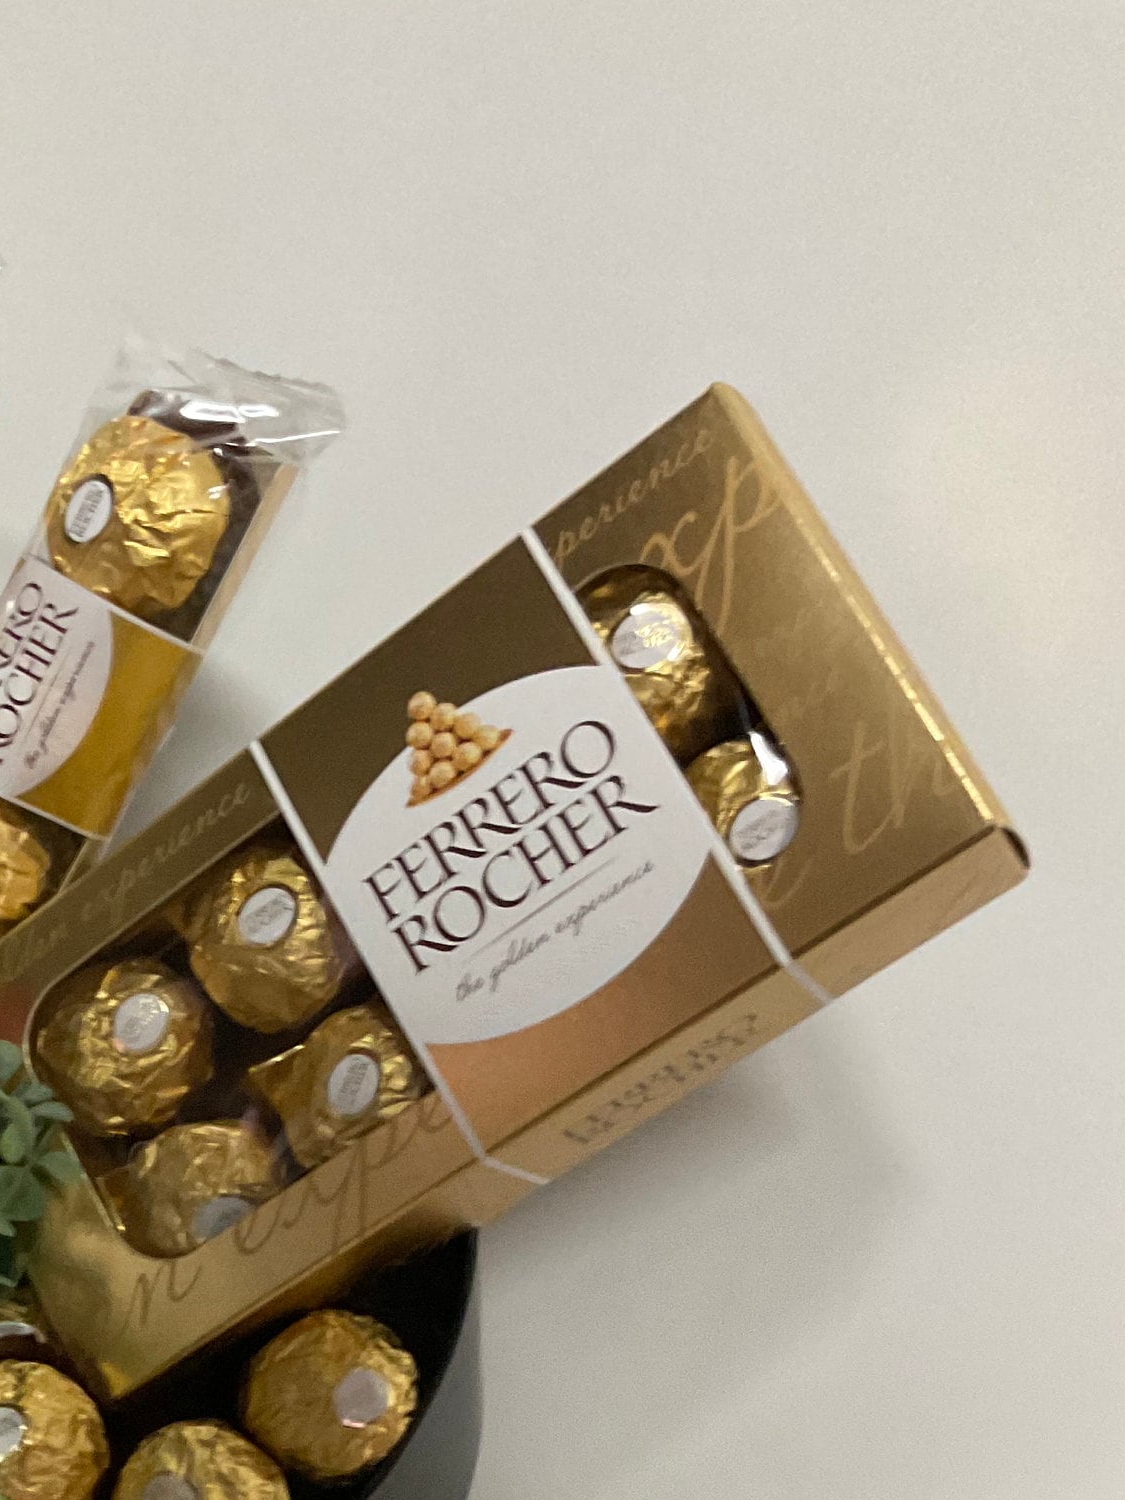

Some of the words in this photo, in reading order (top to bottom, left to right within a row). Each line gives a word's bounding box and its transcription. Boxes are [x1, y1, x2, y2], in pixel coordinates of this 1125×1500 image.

[362, 720, 616, 922] FERRERO
[391, 775, 661, 974] ROCHER
[456, 972, 486, 1002] the
[490, 935, 552, 993] golden
[554, 860, 655, 937] experience
